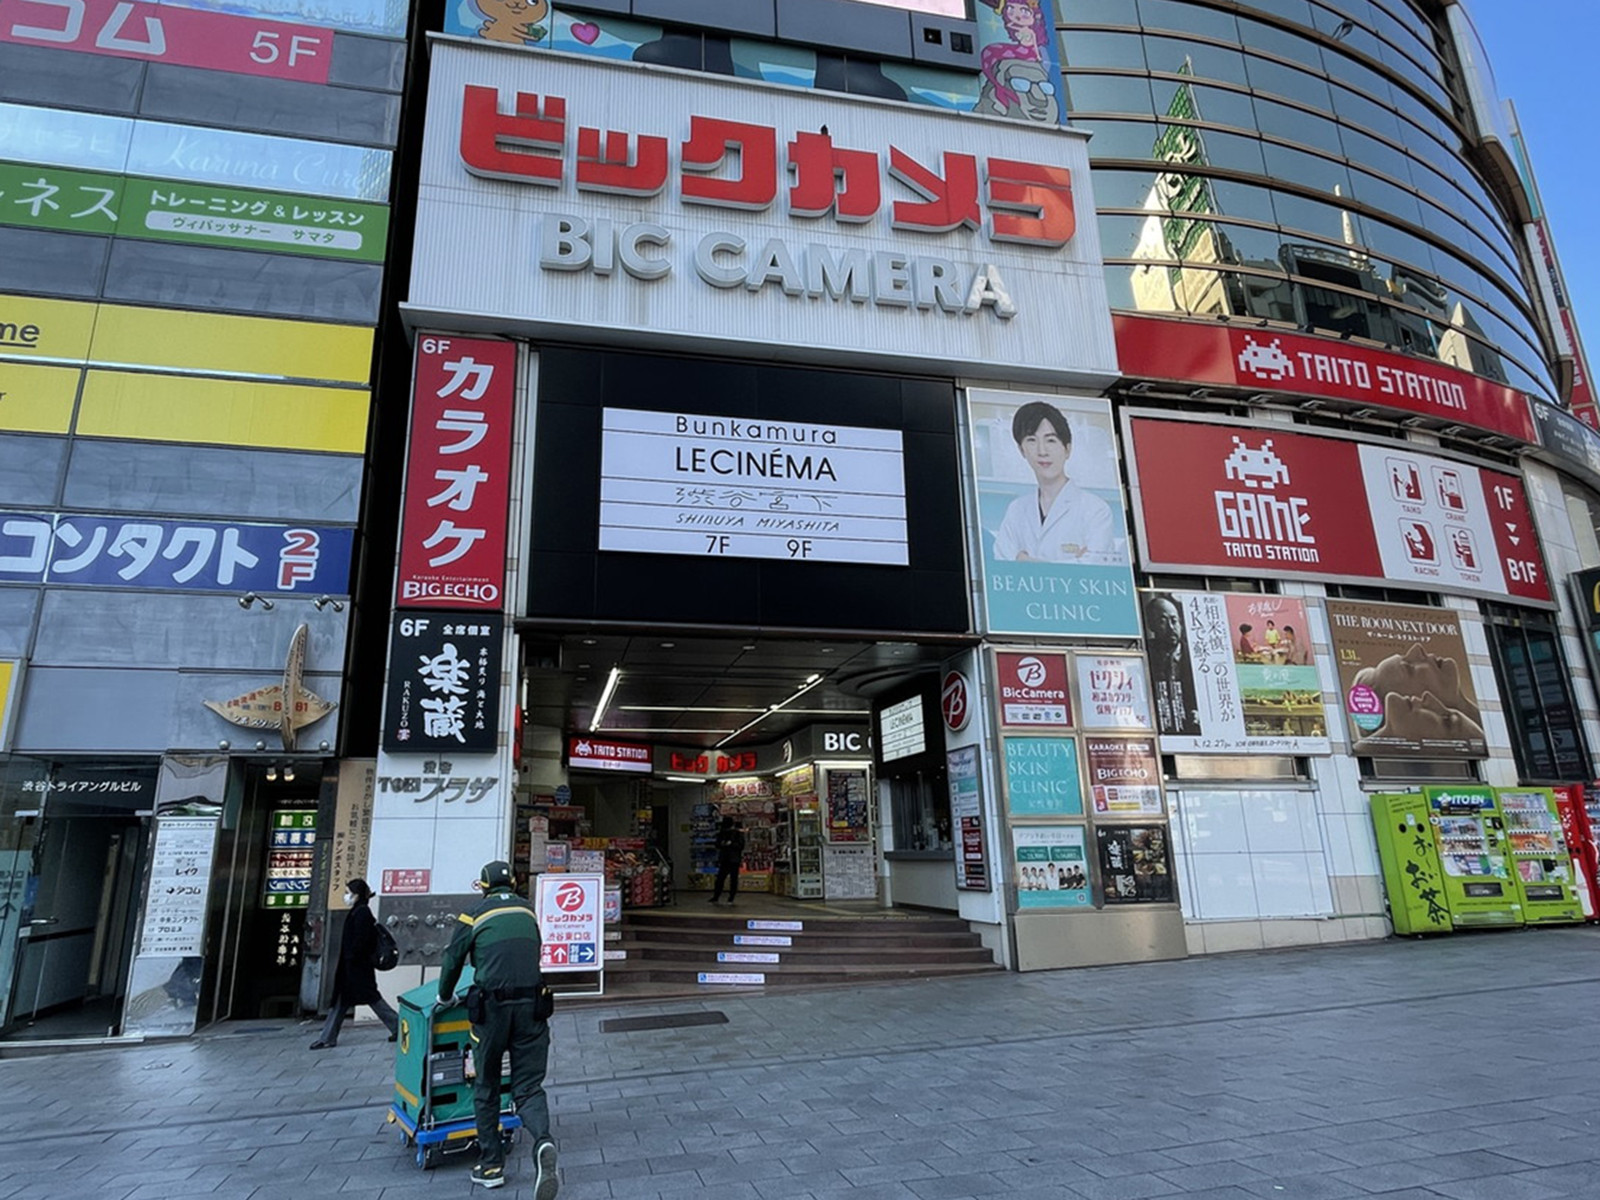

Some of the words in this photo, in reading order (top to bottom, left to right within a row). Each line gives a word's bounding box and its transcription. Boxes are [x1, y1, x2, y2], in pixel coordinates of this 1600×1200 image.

[249, 31, 321, 67] 5F
[460, 84, 1075, 247] ビックカメラ
[0, 177, 118, 221] ネス
[292, 229, 336, 244] サマタ
[540, 212, 671, 279] BIC
[695, 231, 1017, 319] CAMERA
[422, 339, 450, 354] 6F
[1297, 351, 1372, 389] TAITO
[1376, 365, 1467, 410] STATION
[1534, 402, 1550, 420] 6F
[676, 415, 837, 444] Bunkamura
[422, 356, 494, 568] カラオケ
[1493, 485, 1514, 511] 1F
[756, 518, 840, 532] MIYASHITA
[1214, 490, 1315, 544] GAME
[1445, 513, 1466, 523] CRANE
[2, 520, 260, 585] コンタクト
[705, 535, 730, 553] 7F
[787, 539, 812, 558] 9F
[1223, 542, 1262, 558] TAITO
[1265, 545, 1320, 563] STATION
[278, 529, 320, 590] 2F
[1414, 566, 1440, 577] RACING
[1460, 573, 1481, 583] TOKEN
[1506, 557, 1538, 585] B1F
[403, 581, 440, 598] BIG
[443, 584, 498, 601] ECHO
[992, 574, 1073, 594] BEAUTY
[1080, 578, 1128, 596] SKIN
[1026, 602, 1102, 622] CLINIC
[400, 619, 430, 637] 6F
[442, 624, 491, 636] 全席個室
[1333, 613, 1360, 628] THE
[1361, 616, 1394, 631] ROOM
[1395, 619, 1425, 634] NEXT
[1426, 622, 1458, 636] DOOR
[1189, 596, 1211, 674] 4Kで蘇る
[418, 642, 471, 744] 楽蔵
[1003, 687, 1065, 699] BicCamera
[400, 680, 411, 728] RAKUZO
[824, 733, 861, 751] BIC
[1006, 743, 1072, 758] BEAUTY
[1089, 743, 1124, 751] KARAOKE
[593, 745, 615, 757] TAITO
[617, 747, 648, 759] STATION
[1008, 761, 1049, 775] SKIN
[1097, 768, 1118, 780] BIG
[22, 781, 141, 792] 渋谷トライアングルビル
[1010, 780, 1067, 794] CLINIC
[1451, 795, 1470, 804] ITO
[1470, 795, 1485, 805] EN
[175, 868, 199, 876] レイク
[546, 914, 593, 923] ビックカメラ
[547, 932, 591, 942] 渋谷東口店
